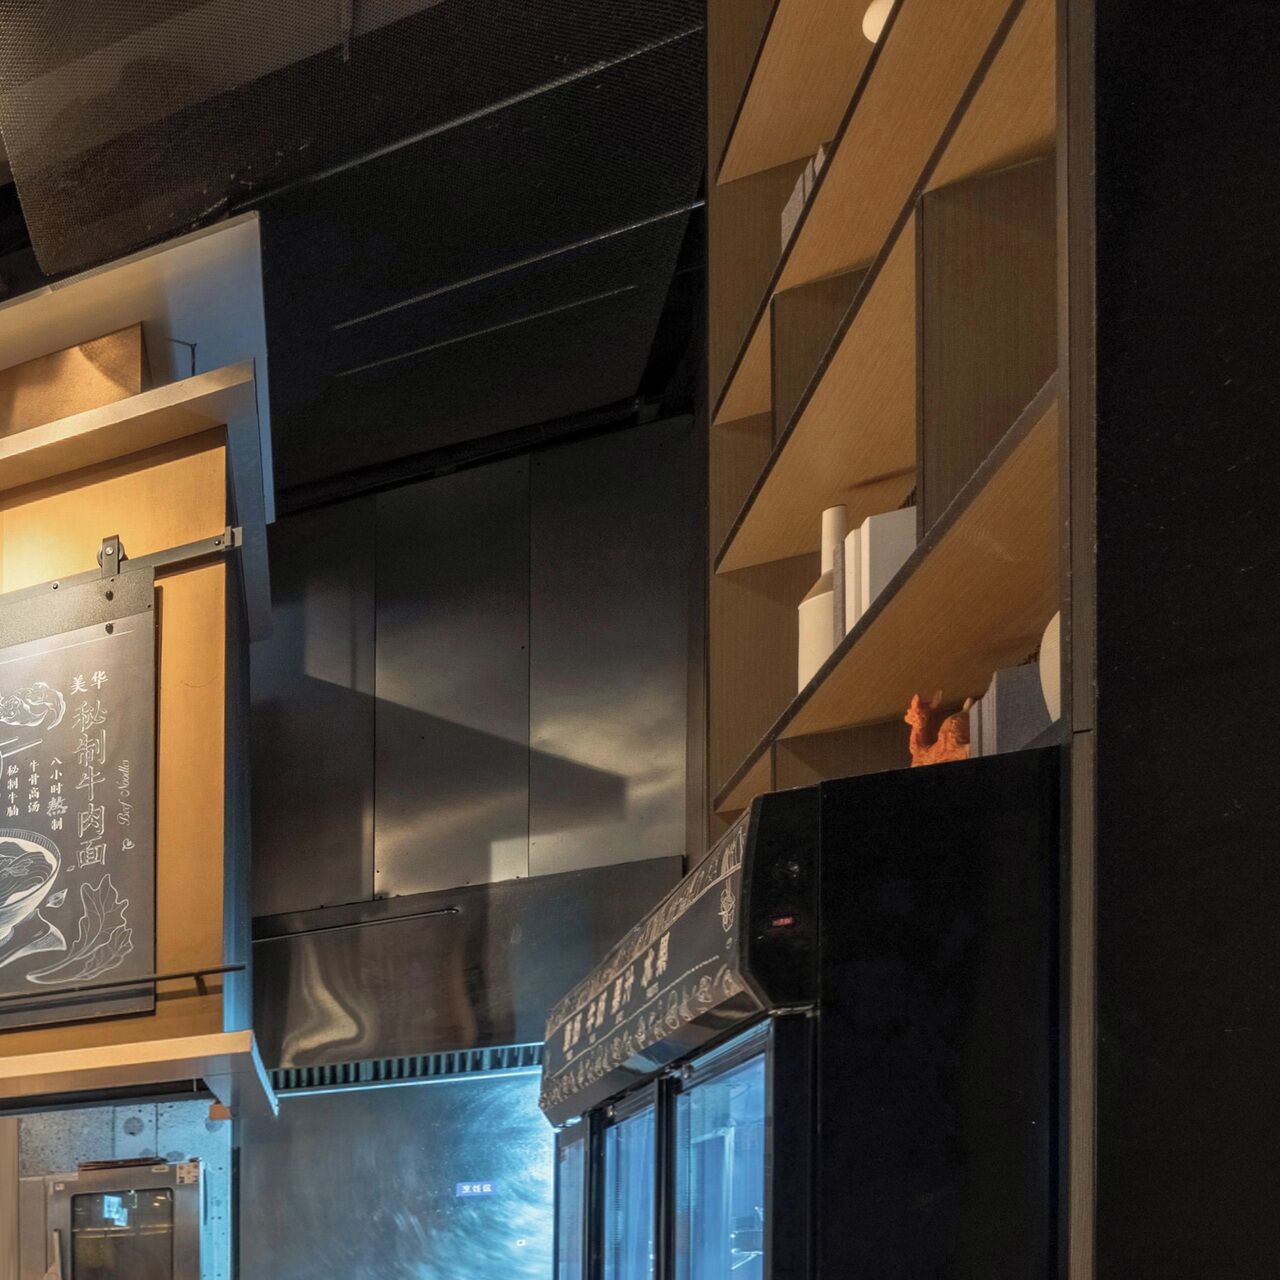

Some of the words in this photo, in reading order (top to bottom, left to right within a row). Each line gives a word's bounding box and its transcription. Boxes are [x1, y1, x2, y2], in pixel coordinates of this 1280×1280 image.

[70, 670, 109, 696] 美华
[72, 700, 109, 870] 秘制牛肉面
